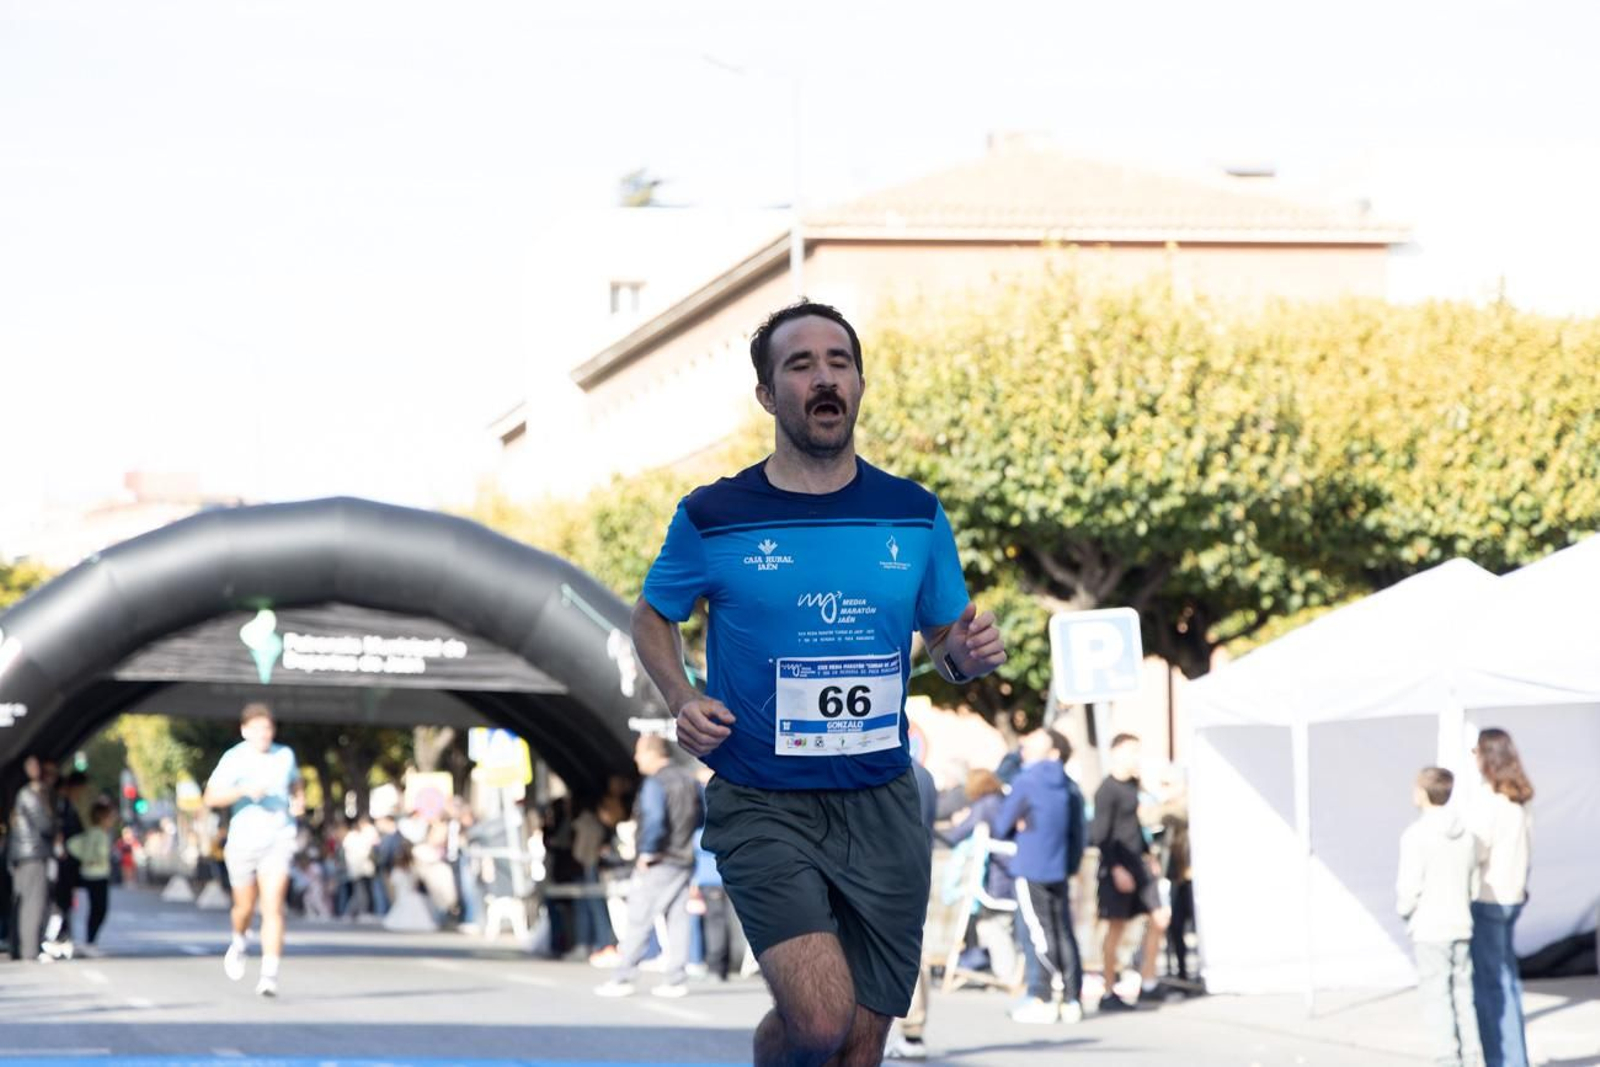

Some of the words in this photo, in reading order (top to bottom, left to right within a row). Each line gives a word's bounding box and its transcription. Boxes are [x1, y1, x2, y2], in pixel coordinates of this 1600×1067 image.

[744, 556, 763, 564] CAJA
[758, 563, 778, 571] JAÉN
[840, 607, 876, 615] MARATÓN
[837, 616, 856, 624] JAÉN
[1068, 621, 1124, 693] P
[818, 685, 871, 718] 66
[826, 721, 863, 730] GONZALO
